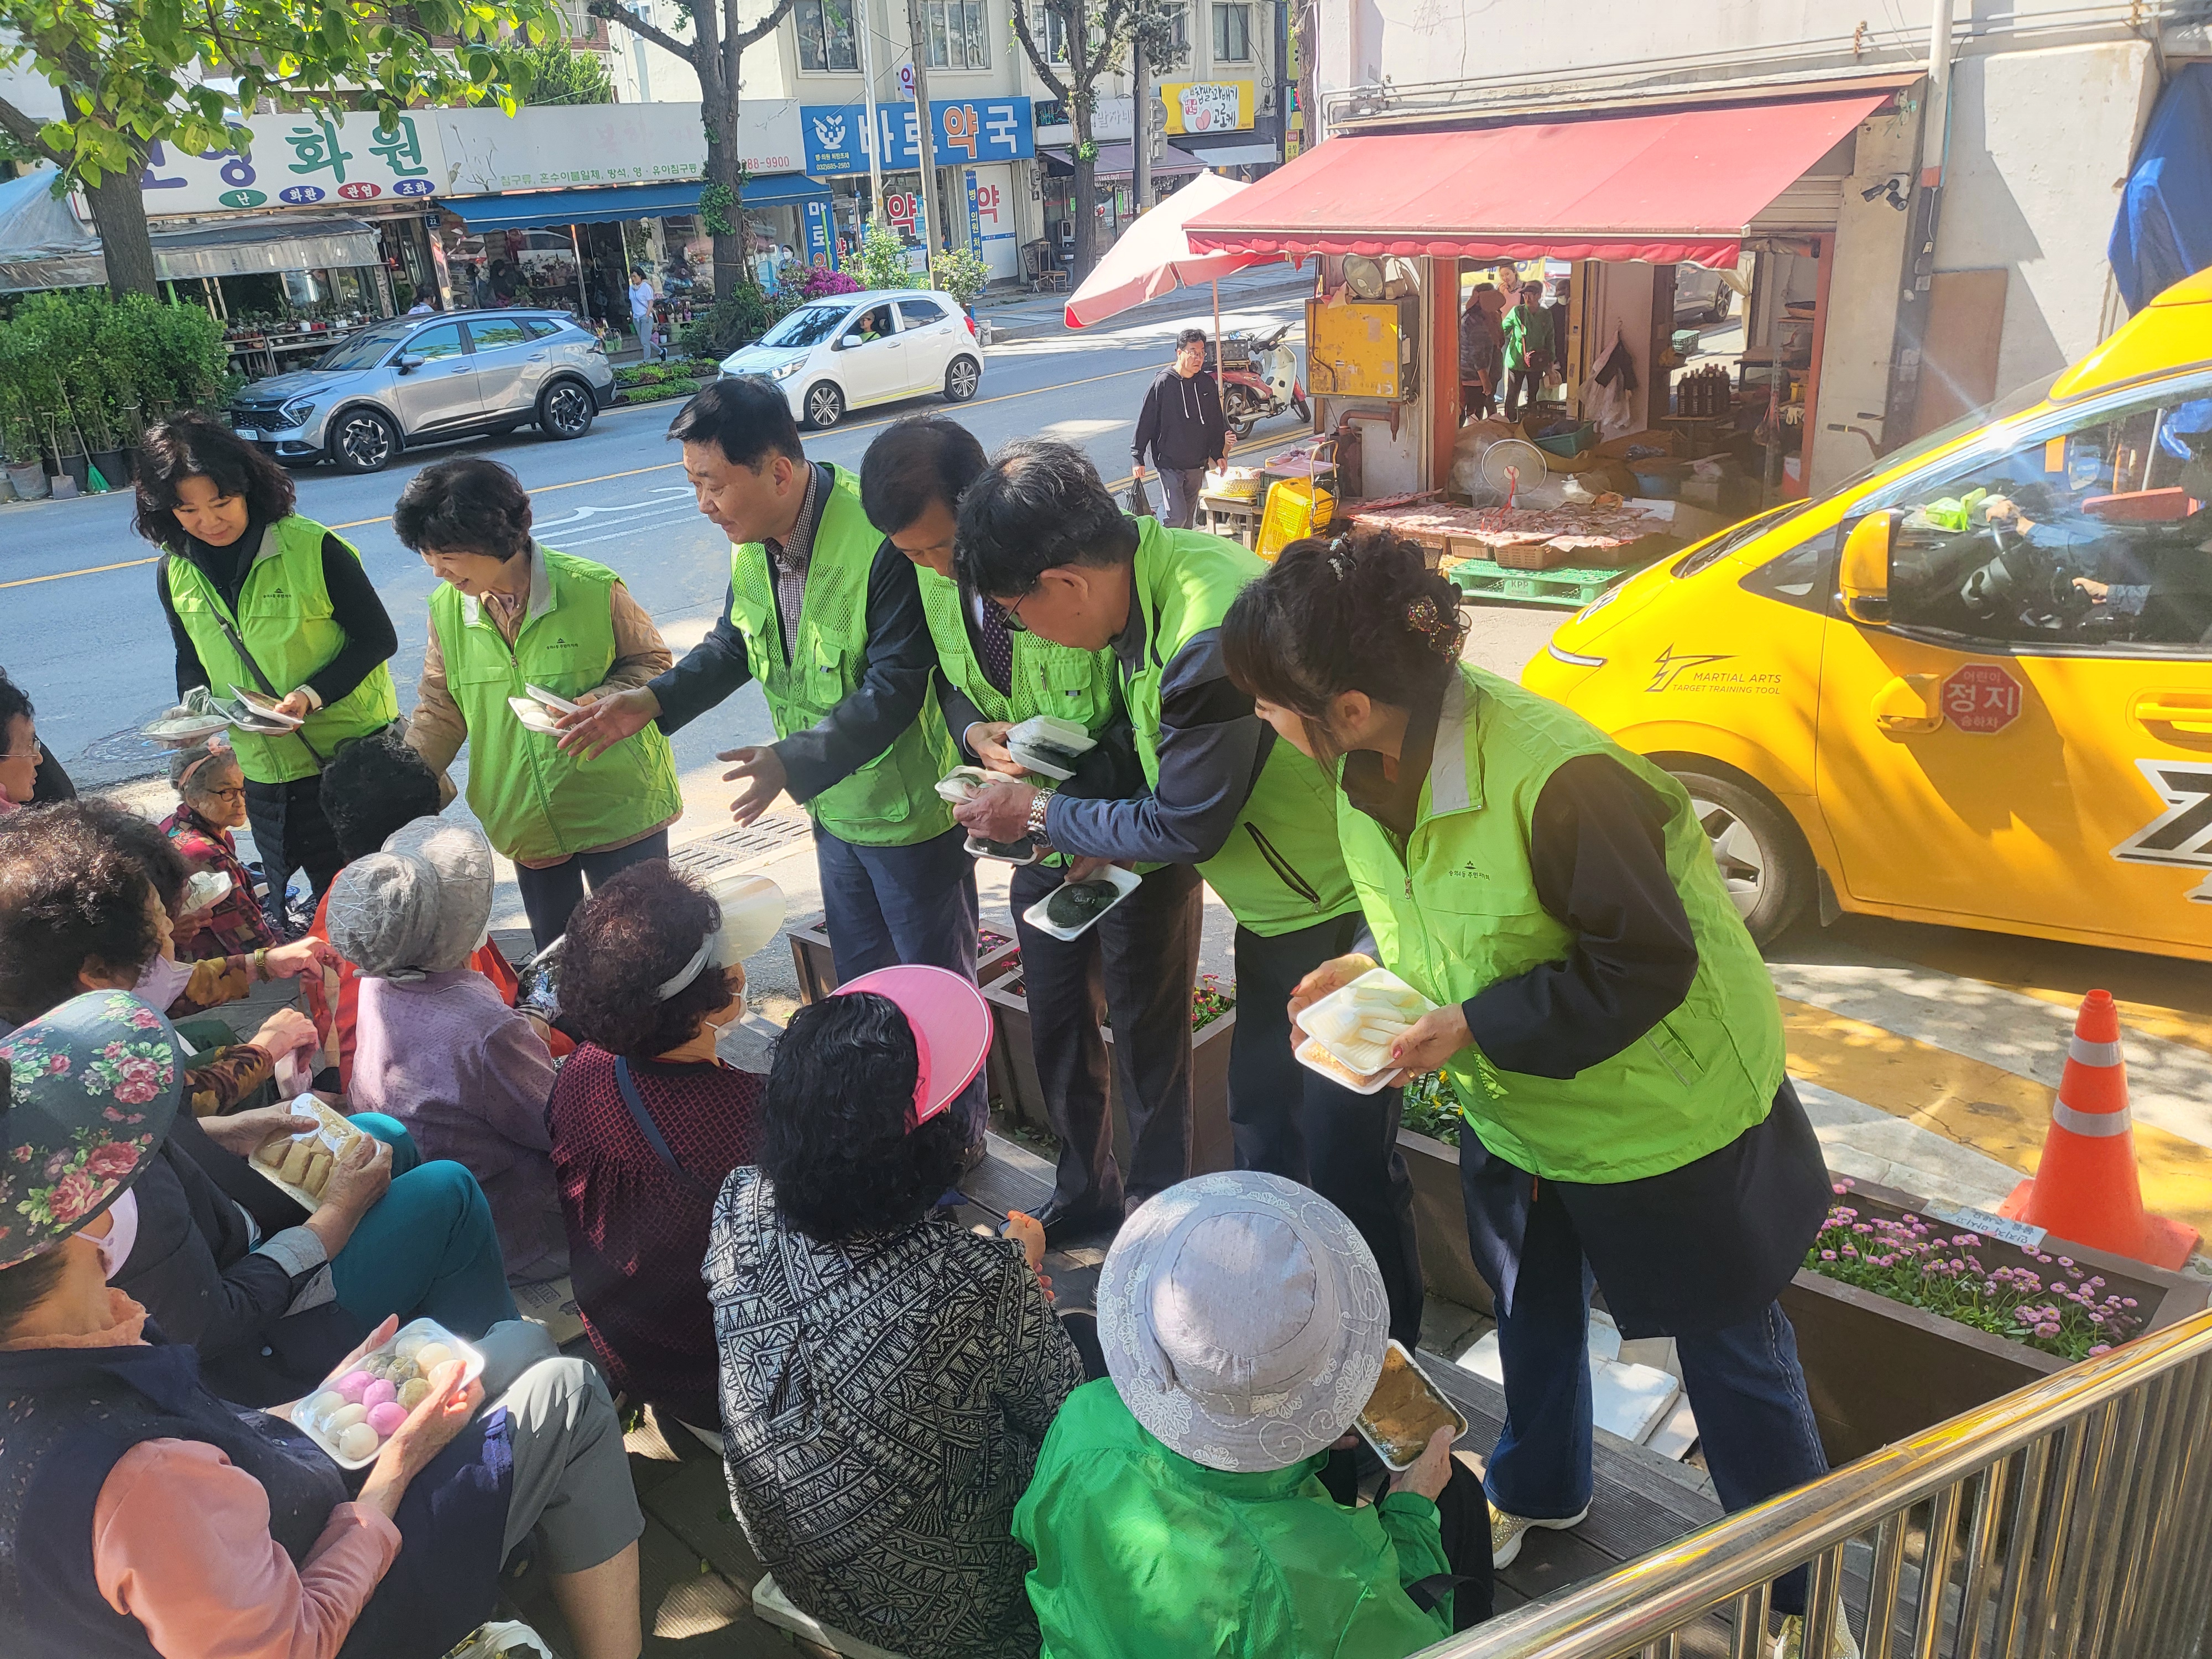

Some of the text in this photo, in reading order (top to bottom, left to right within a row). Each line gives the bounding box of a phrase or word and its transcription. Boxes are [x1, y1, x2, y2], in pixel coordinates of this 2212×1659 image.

[1194, 85, 1238, 105] 찹쌀꽈배기
[858, 103, 1018, 163] 바로약국
[285, 116, 429, 184] 화원
[289, 186, 317, 202] 화환
[346, 184, 374, 199] 관엽
[401, 181, 427, 194] 조화
[236, 191, 251, 206] 난
[977, 184, 1000, 223] 약
[888, 192, 917, 236] 약
[1511, 580, 1528, 588] KPP
[1693, 672, 1782, 684] MARTIAL ARTS
[1963, 670, 2001, 684] 어린이
[1673, 684, 1781, 695] TARGET TRAINING TOOL
[1947, 683, 2014, 716] 정지
[1956, 1217, 1989, 1231] 마시고
